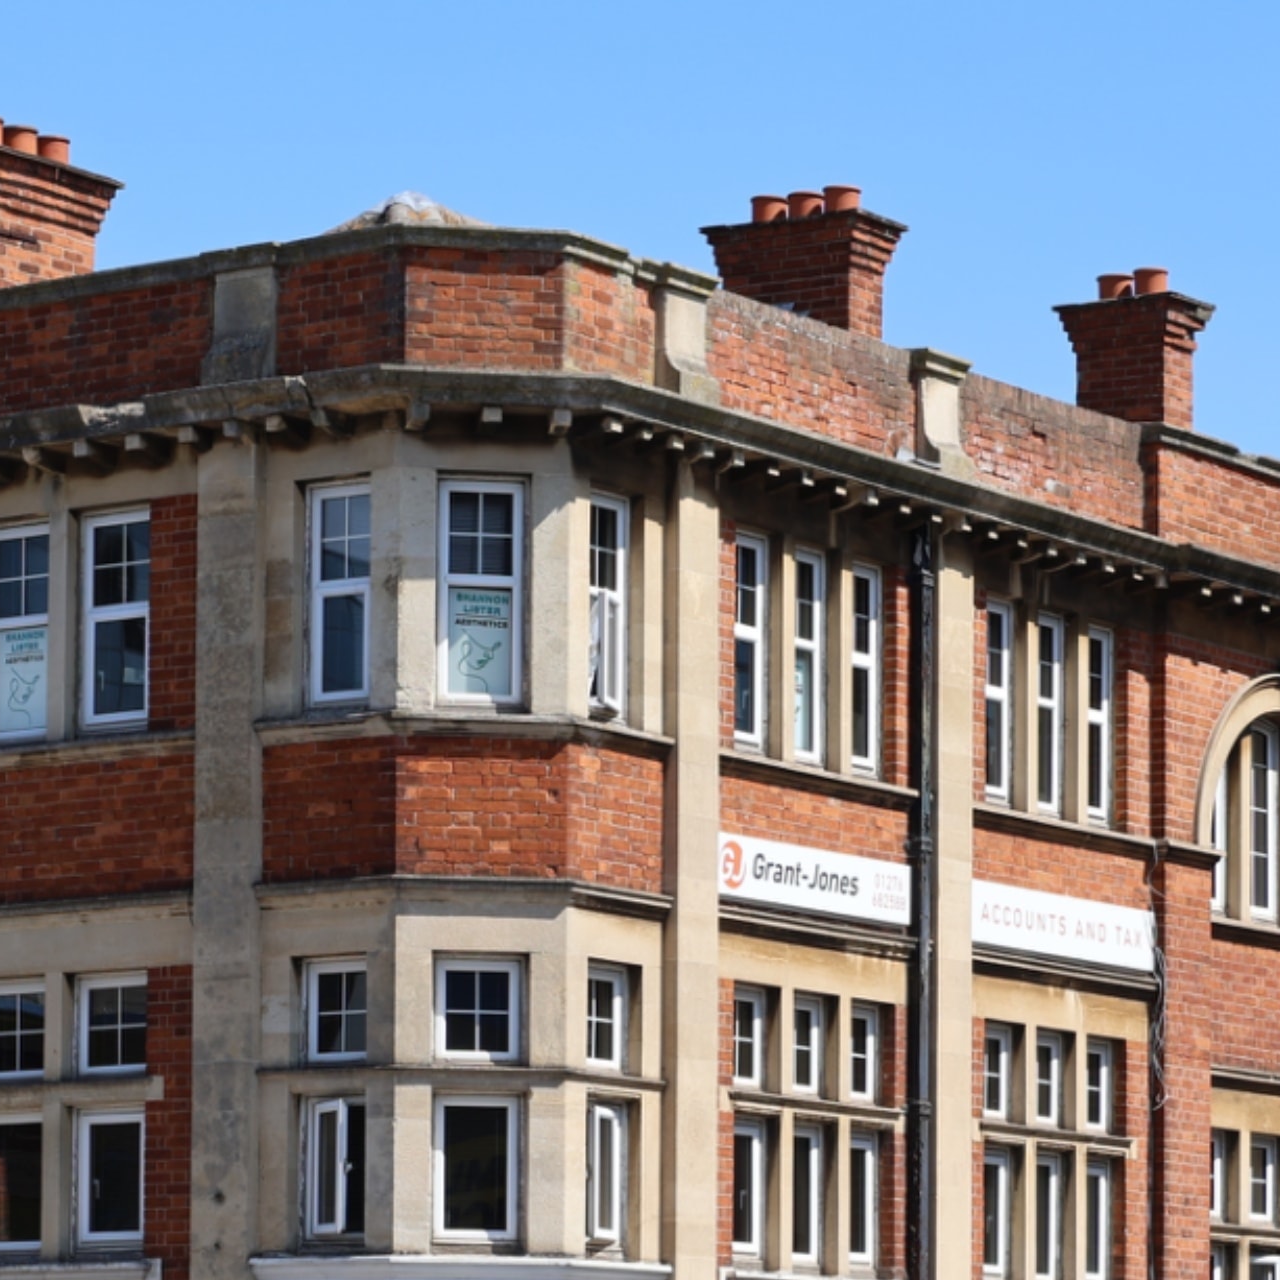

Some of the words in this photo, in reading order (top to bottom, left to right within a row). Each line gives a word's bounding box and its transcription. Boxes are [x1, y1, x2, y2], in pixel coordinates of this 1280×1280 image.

[456, 592, 509, 604] SHANNON
[463, 605, 501, 616] LISTER
[455, 618, 508, 629] AESTHETICS
[752, 853, 858, 896] Grant-Jones
[981, 902, 1067, 937] ACCOUNTS
[1075, 919, 1107, 943] AND
[1115, 926, 1143, 949] TAX
